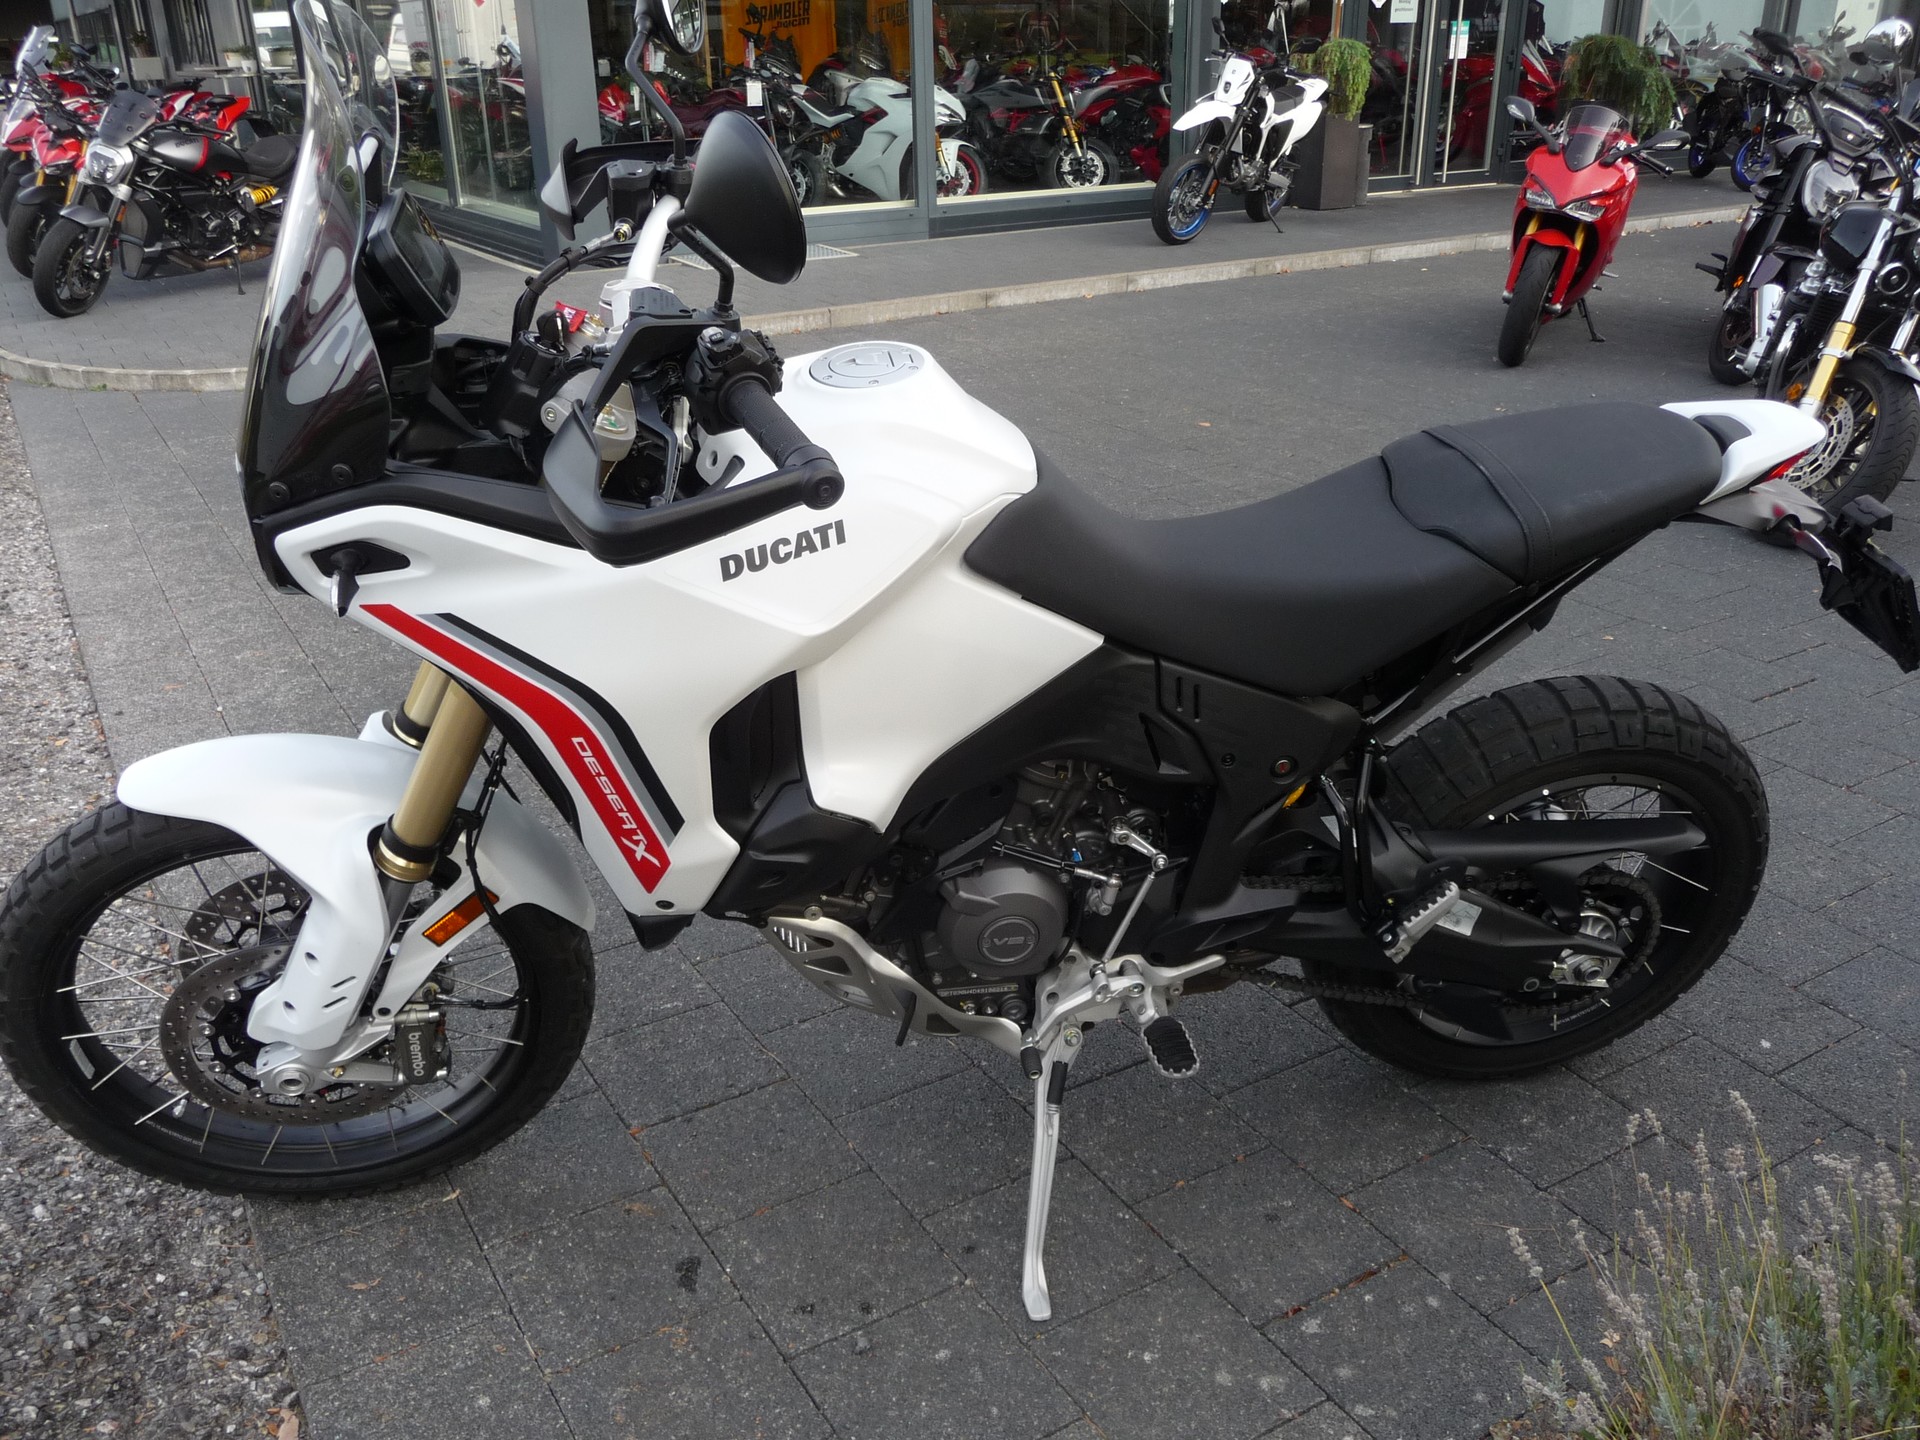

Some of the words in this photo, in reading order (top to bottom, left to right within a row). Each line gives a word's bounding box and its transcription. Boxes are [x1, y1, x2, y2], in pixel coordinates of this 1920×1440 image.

[719, 519, 846, 582] DUCATI
[571, 736, 661, 868] DESERTX
[408, 1032, 426, 1077] brembo
